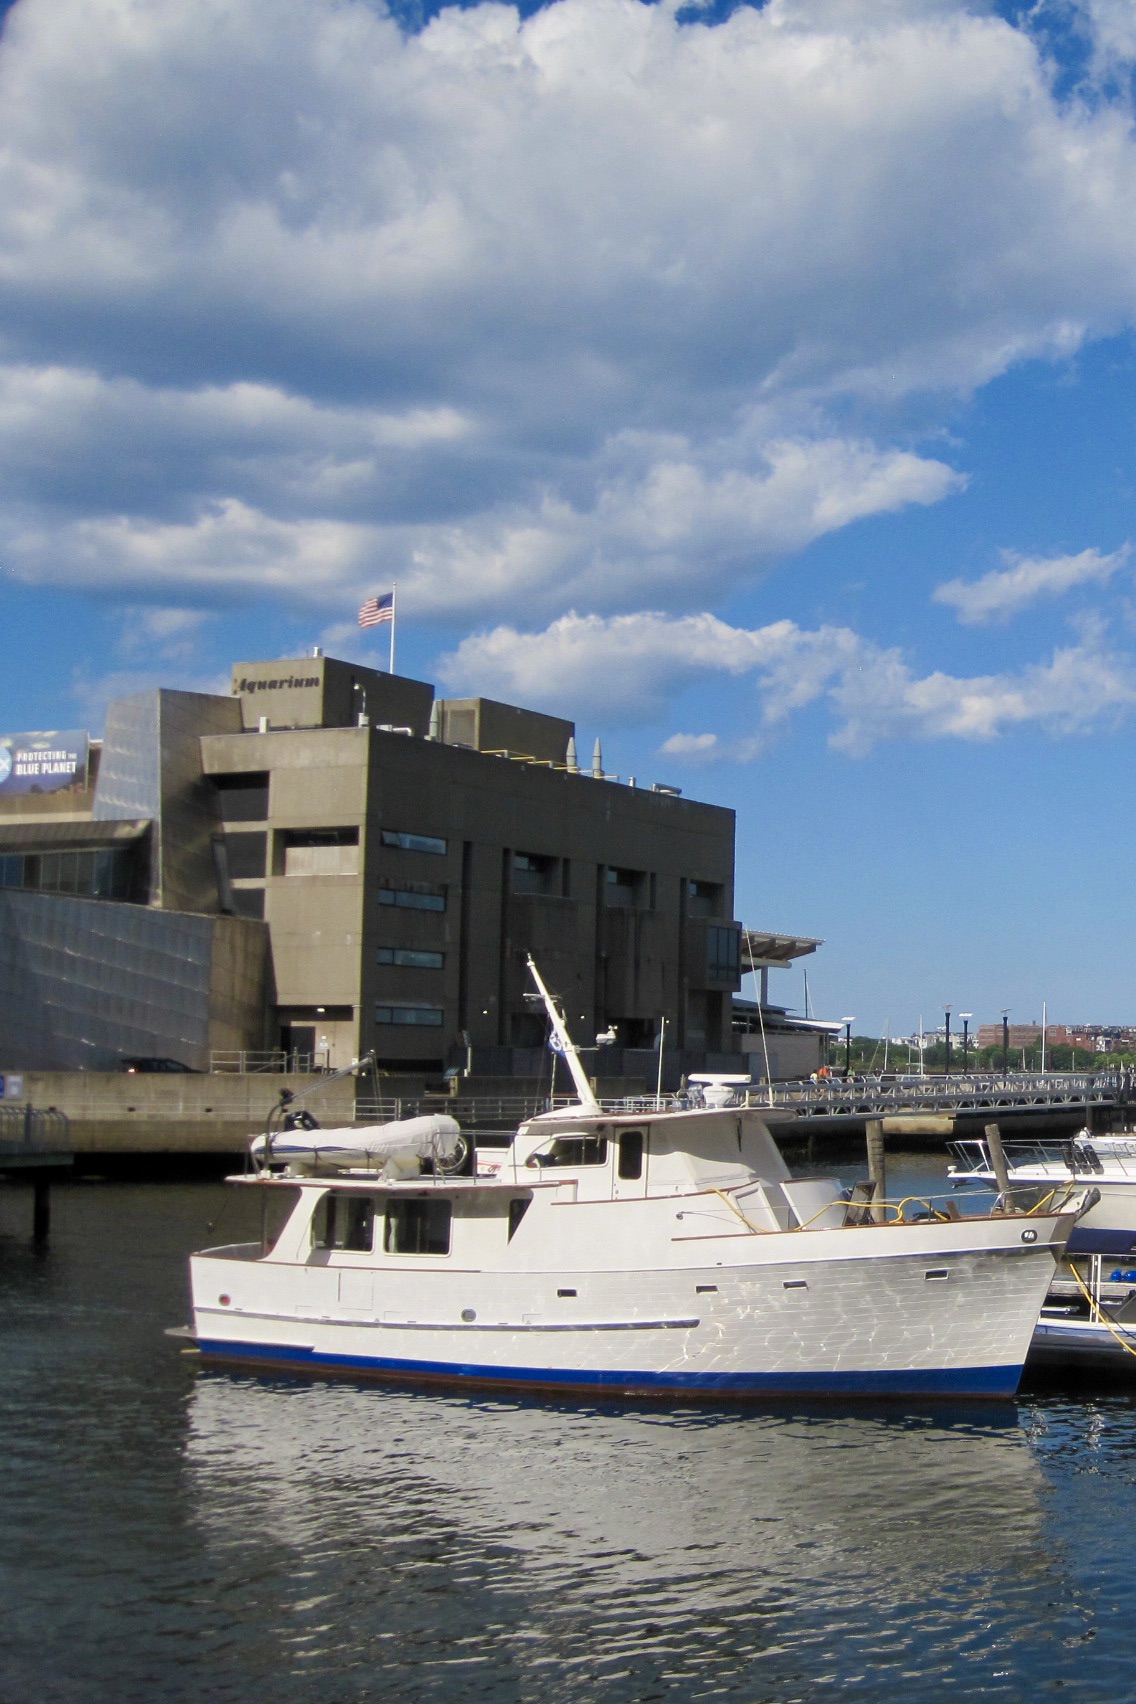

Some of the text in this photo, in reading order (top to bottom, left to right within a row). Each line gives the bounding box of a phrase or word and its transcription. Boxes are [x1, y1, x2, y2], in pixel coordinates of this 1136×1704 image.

[17, 751, 67, 761] PROTECTING
[16, 762, 77, 775] BLUE PLANET
